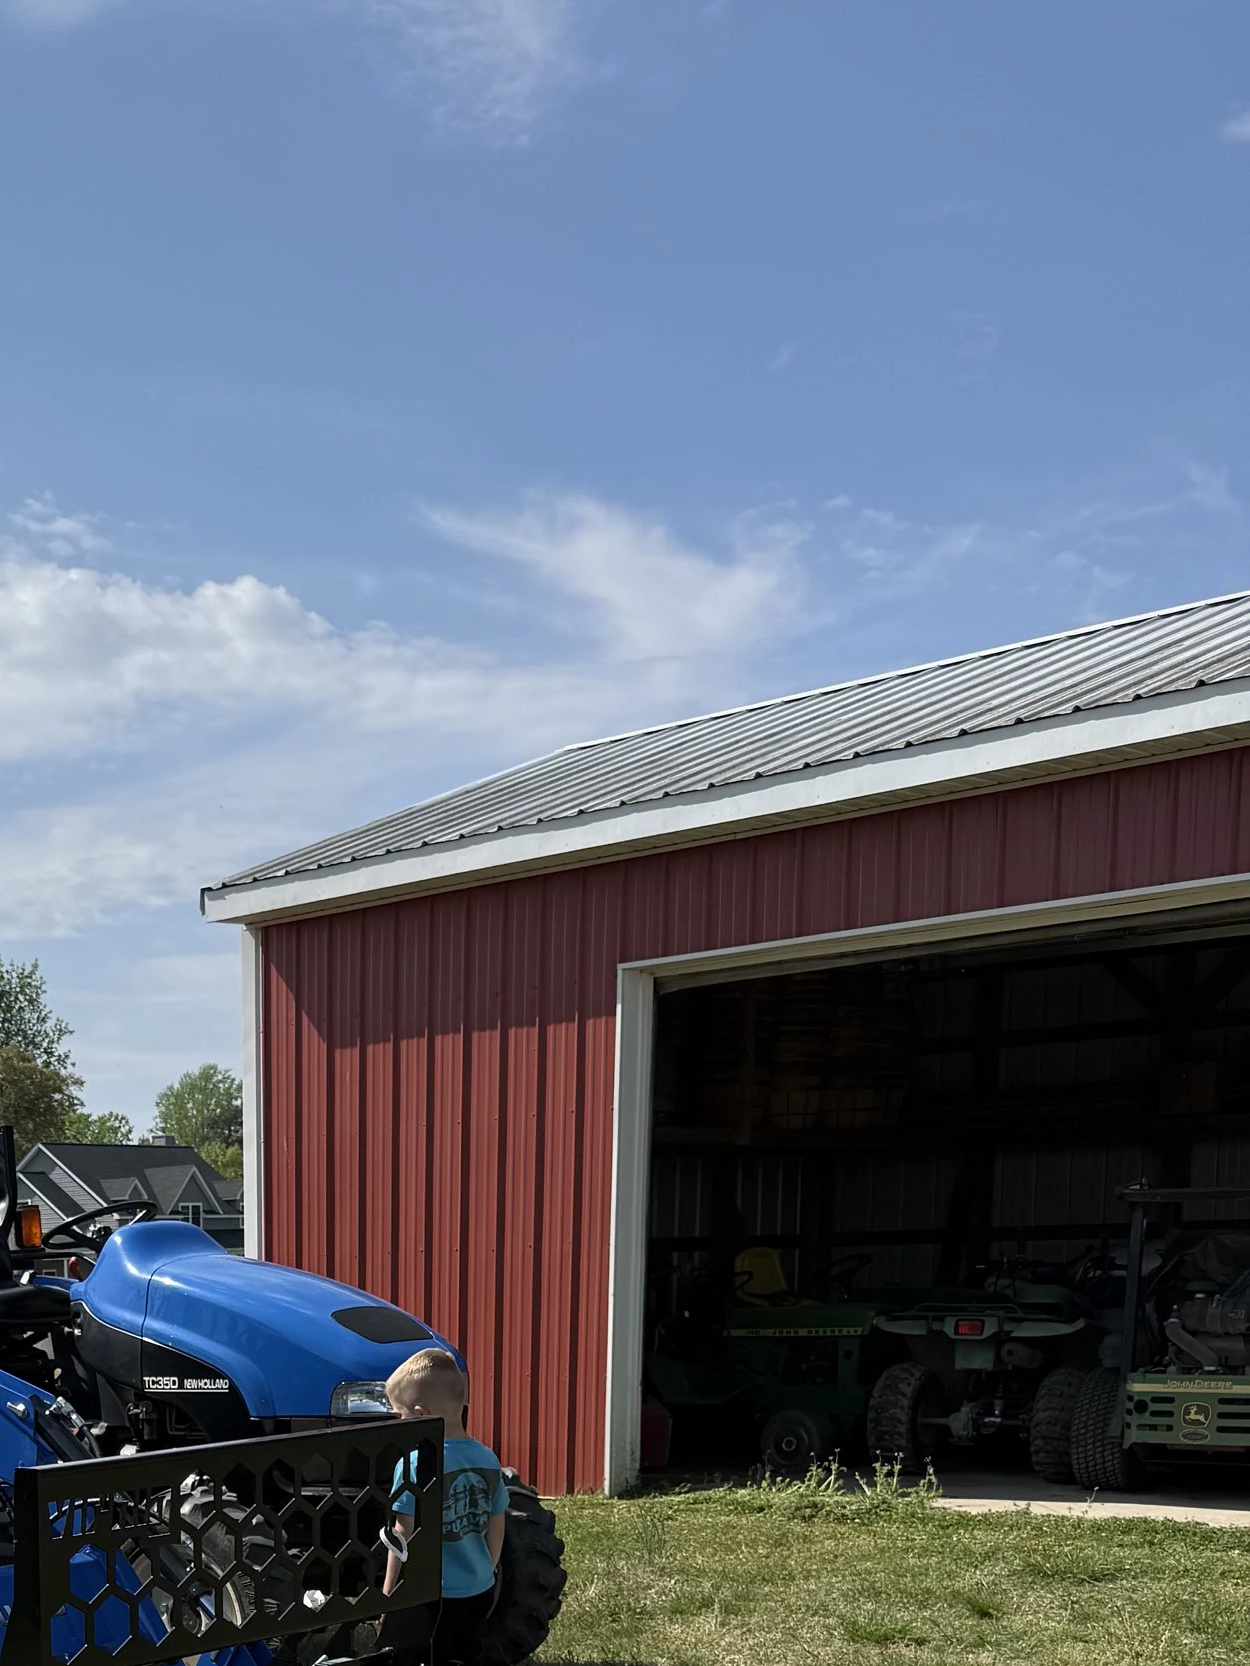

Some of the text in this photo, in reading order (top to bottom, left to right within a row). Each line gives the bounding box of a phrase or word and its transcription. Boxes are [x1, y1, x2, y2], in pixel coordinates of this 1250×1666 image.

[143, 1376, 229, 1389] TC35D NEW HOLLAND
[1164, 1379, 1233, 1390] JOHN DEERE
